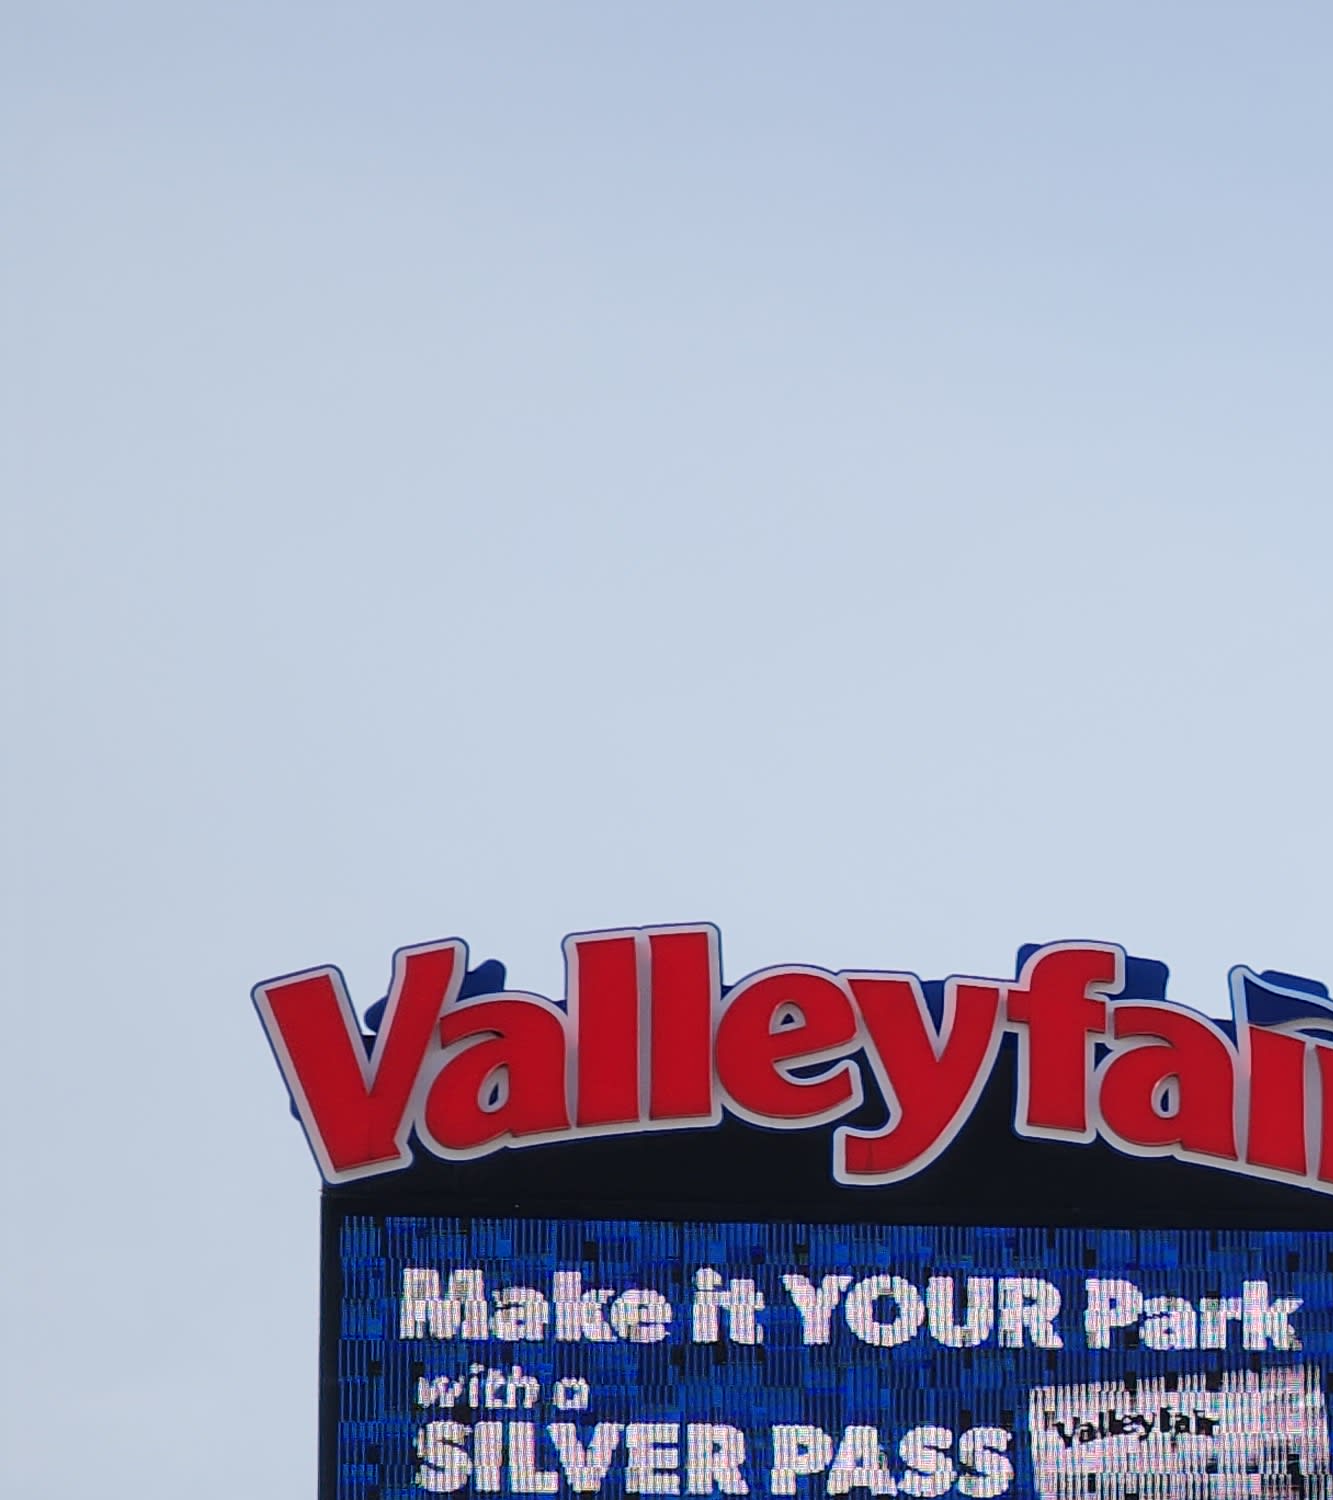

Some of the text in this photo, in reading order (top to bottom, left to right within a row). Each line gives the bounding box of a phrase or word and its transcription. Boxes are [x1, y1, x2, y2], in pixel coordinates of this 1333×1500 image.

[400, 1268, 1303, 1351] Make it YOUR Park
[416, 1363, 590, 1409] with a
[415, 1421, 1016, 1498] SILVER PASS
